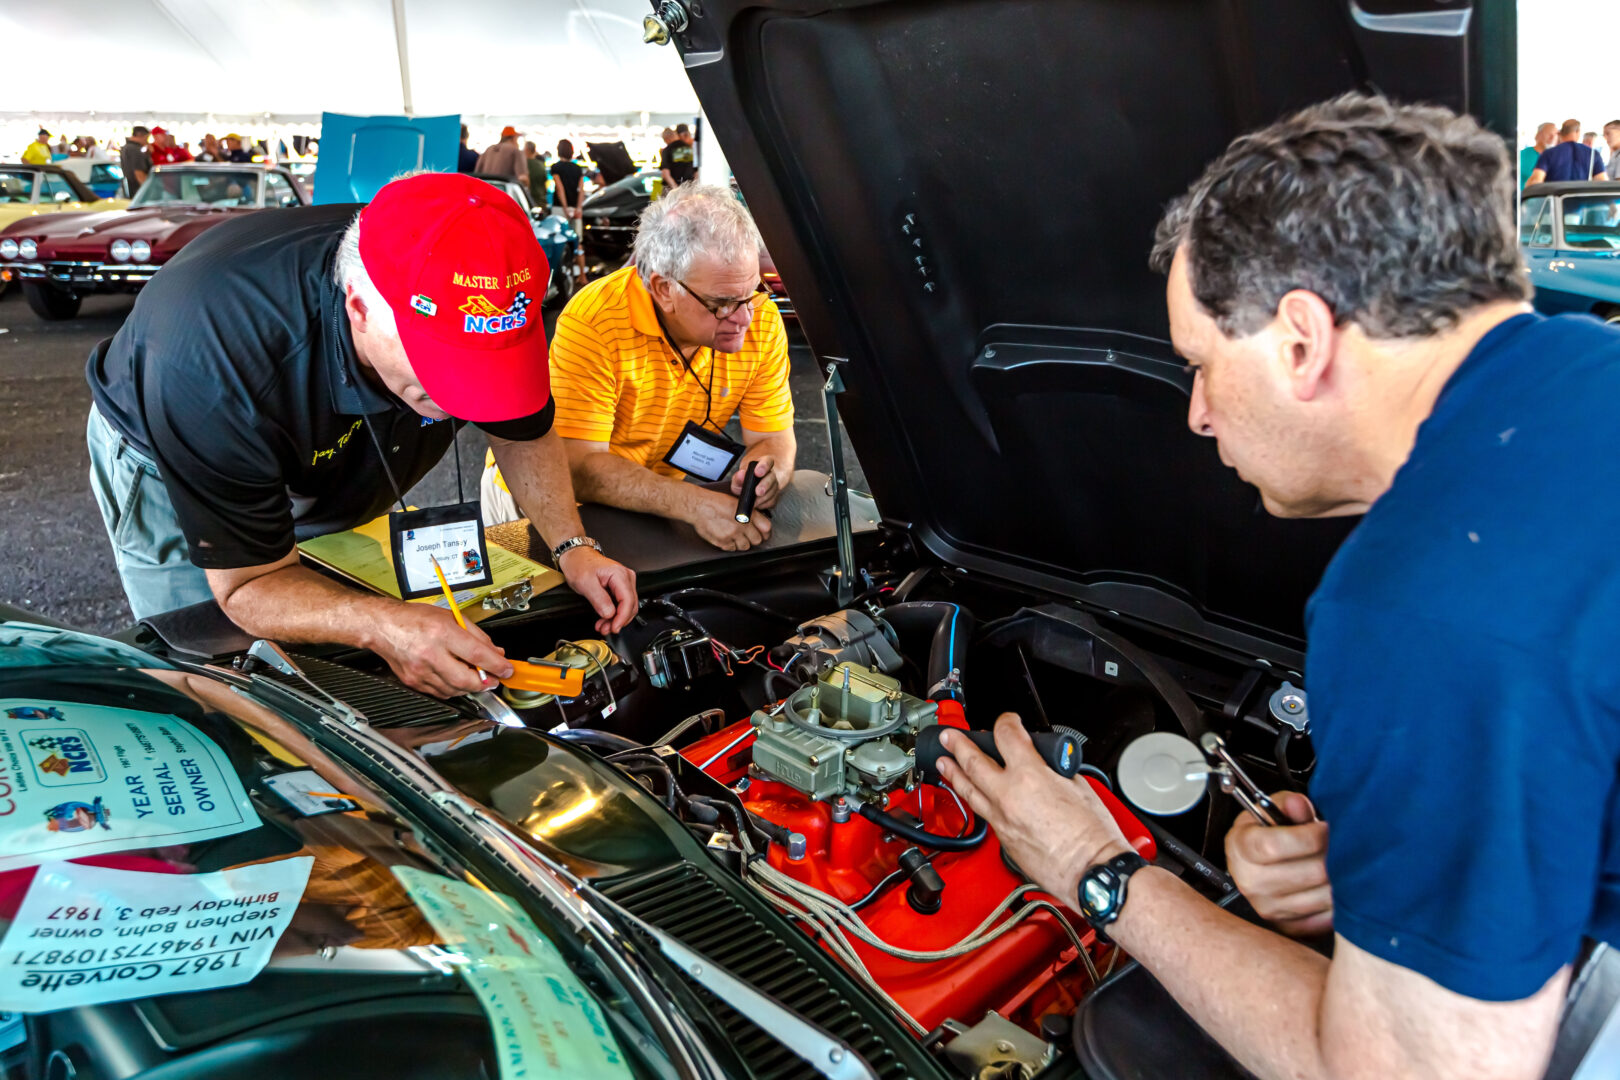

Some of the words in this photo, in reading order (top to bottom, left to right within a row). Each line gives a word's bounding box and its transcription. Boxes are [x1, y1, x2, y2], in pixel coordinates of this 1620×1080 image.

[452, 271, 500, 290] MASTER
[464, 310, 528, 334] NCRS
[312, 448, 334, 466] Jay
[416, 542, 440, 552] Joseph
[442, 539, 468, 548] Tansy
[60, 736, 94, 773] NCRS
[153, 762, 185, 815] SERIAL
[180, 758, 215, 812] OWNER
[125, 775, 154, 819] YEAR
[140, 905, 182, 919] Feb
[188, 891, 280, 912] Birthday
[46, 906, 103, 921] 1967
[115, 906, 134, 921] 3,
[185, 907, 281, 929] Stephen
[28, 927, 104, 938] owner
[112, 920, 178, 938] Bahn,
[229, 925, 275, 945] VIN
[12, 935, 218, 965] 194677S109871
[169, 951, 241, 976] 1967
[21, 963, 162, 992] Corvette
